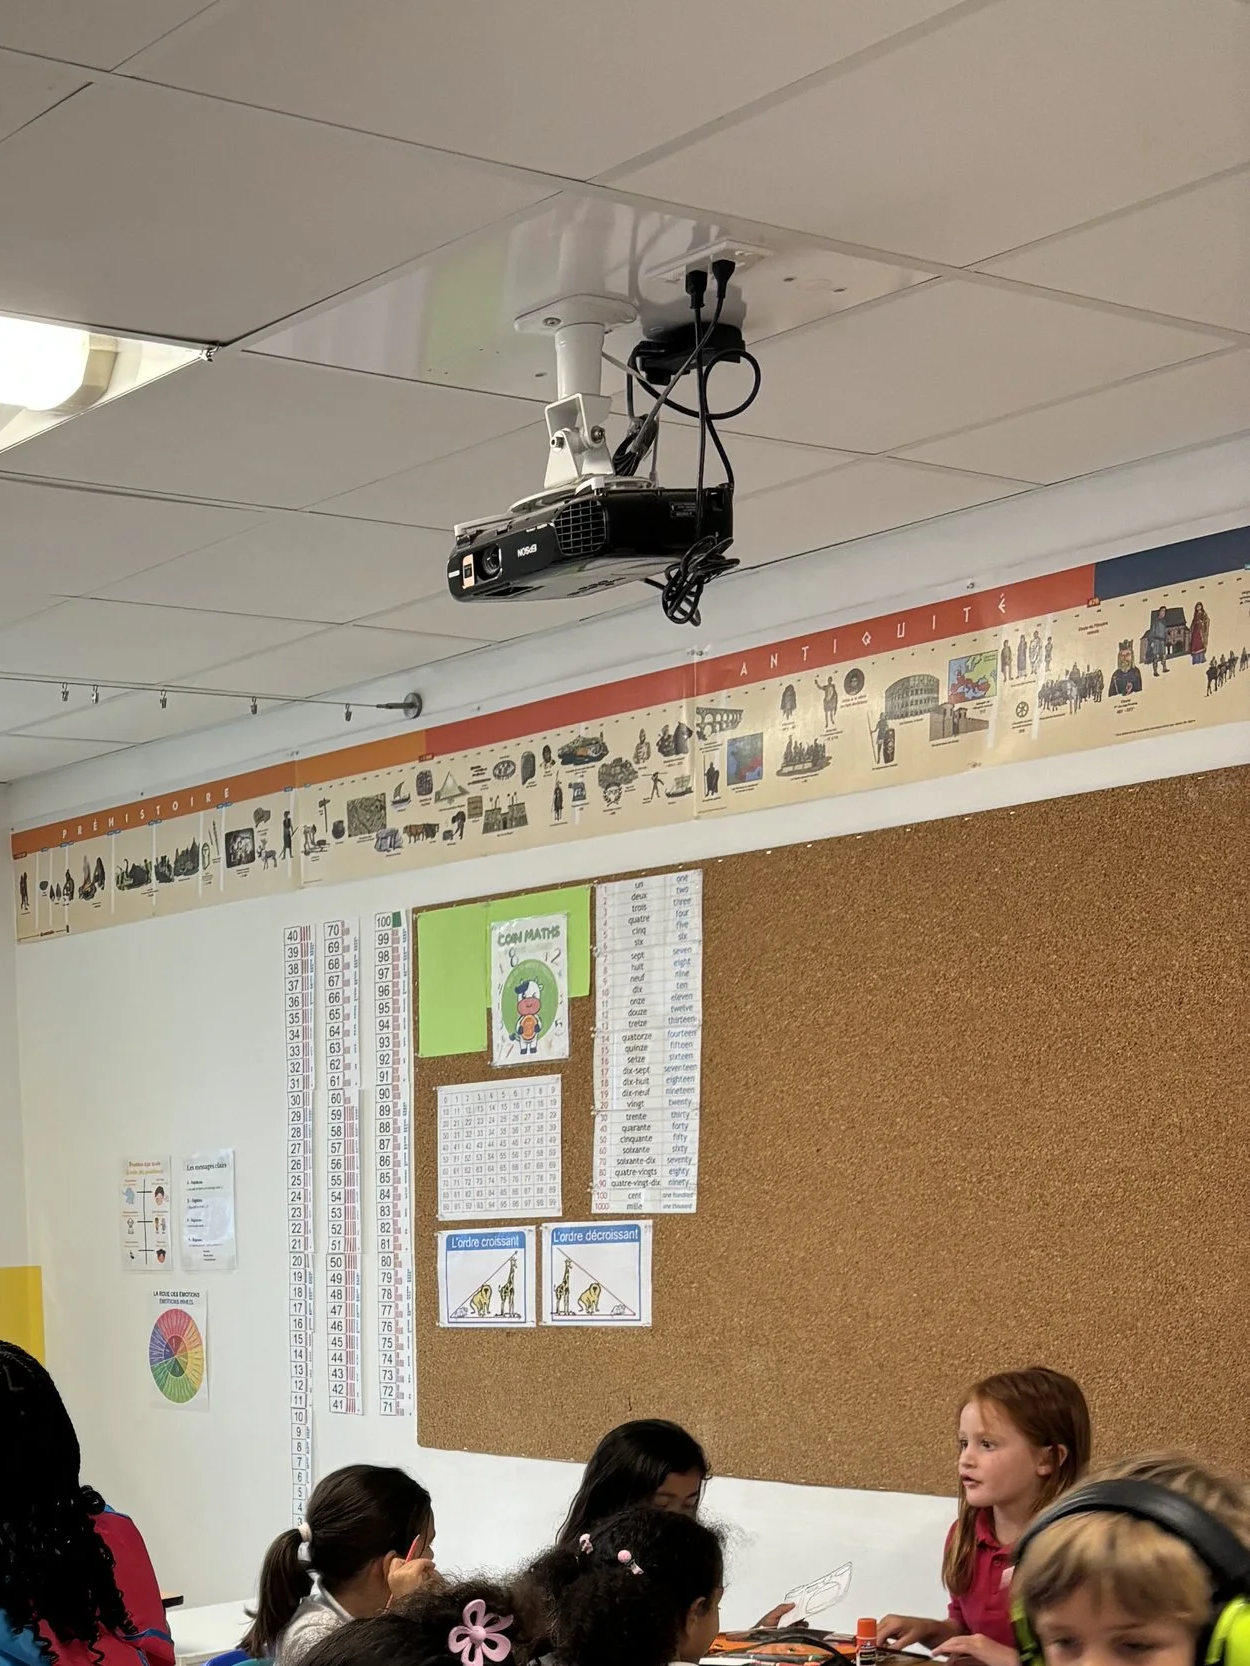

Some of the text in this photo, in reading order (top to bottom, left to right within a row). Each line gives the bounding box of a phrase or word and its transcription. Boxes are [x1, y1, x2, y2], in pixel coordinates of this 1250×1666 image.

[517, 543, 537, 558] EPSON
[740, 593, 1005, 676] ANTIQUITÉ
[62, 788, 230, 839] PRÉHISTOIRE
[377, 915, 391, 928] 100
[287, 930, 298, 941] 40
[378, 933, 389, 945] 99
[497, 925, 560, 947] COIN MATHS
[288, 947, 298, 958] 39
[378, 950, 389, 963] 98
[288, 963, 299, 975] 38
[378, 967, 389, 980] 97
[288, 979, 299, 991] 37
[378, 985, 390, 997] 96
[289, 996, 299, 1008] 36
[379, 1002, 390, 1014] 95
[289, 1013, 299, 1024] 35
[379, 1019, 390, 1031] 94
[289, 1029, 300, 1040] 34
[379, 1036, 390, 1048] 93
[290, 1046, 300, 1057] 33
[379, 1053, 390, 1065] 92
[290, 1062, 300, 1073] 32
[380, 1071, 388, 1082] 91
[290, 1078, 299, 1089] 31
[379, 1088, 390, 1099] 90
[291, 1095, 300, 1106] 30
[291, 1111, 301, 1121] 29
[379, 1105, 390, 1116] 89
[291, 1127, 301, 1138] 28
[379, 1122, 390, 1133] 88
[291, 1143, 301, 1154] 27
[379, 1138, 390, 1150] 87
[291, 1159, 301, 1170] 26
[379, 1155, 390, 1167] 86
[291, 1175, 301, 1186] 25
[380, 1172, 390, 1183] 85
[291, 1191, 301, 1202] 24
[380, 1189, 390, 1200] 84
[291, 1207, 301, 1218] 23
[380, 1205, 390, 1217] 83
[292, 1223, 301, 1233] 22
[380, 1222, 390, 1233] 82
[553, 1228, 638, 1242] L'ordre décroissant
[292, 1239, 301, 1249] 21
[381, 1239, 389, 1249] 81
[451, 1235, 519, 1249] L'ordre croissant
[292, 1256, 302, 1266] 20
[381, 1256, 391, 1267] 80
[294, 1271, 302, 1282] 19
[382, 1272, 392, 1283] 79
[294, 1287, 302, 1298] 18
[382, 1288, 392, 1299] 78
[294, 1302, 302, 1313] 17
[382, 1305, 392, 1315] 77
[294, 1318, 302, 1329] 16
[382, 1321, 392, 1332] 76
[294, 1334, 303, 1344] 15
[382, 1337, 392, 1348] 75
[294, 1350, 303, 1359] 14
[382, 1354, 392, 1364] 74
[295, 1365, 303, 1375] 13
[382, 1370, 393, 1380] 73
[295, 1380, 303, 1391] 12
[383, 1386, 393, 1396] 72
[295, 1395, 303, 1405] 11
[382, 1402, 392, 1412] 71
[295, 1412, 303, 1422] 10
